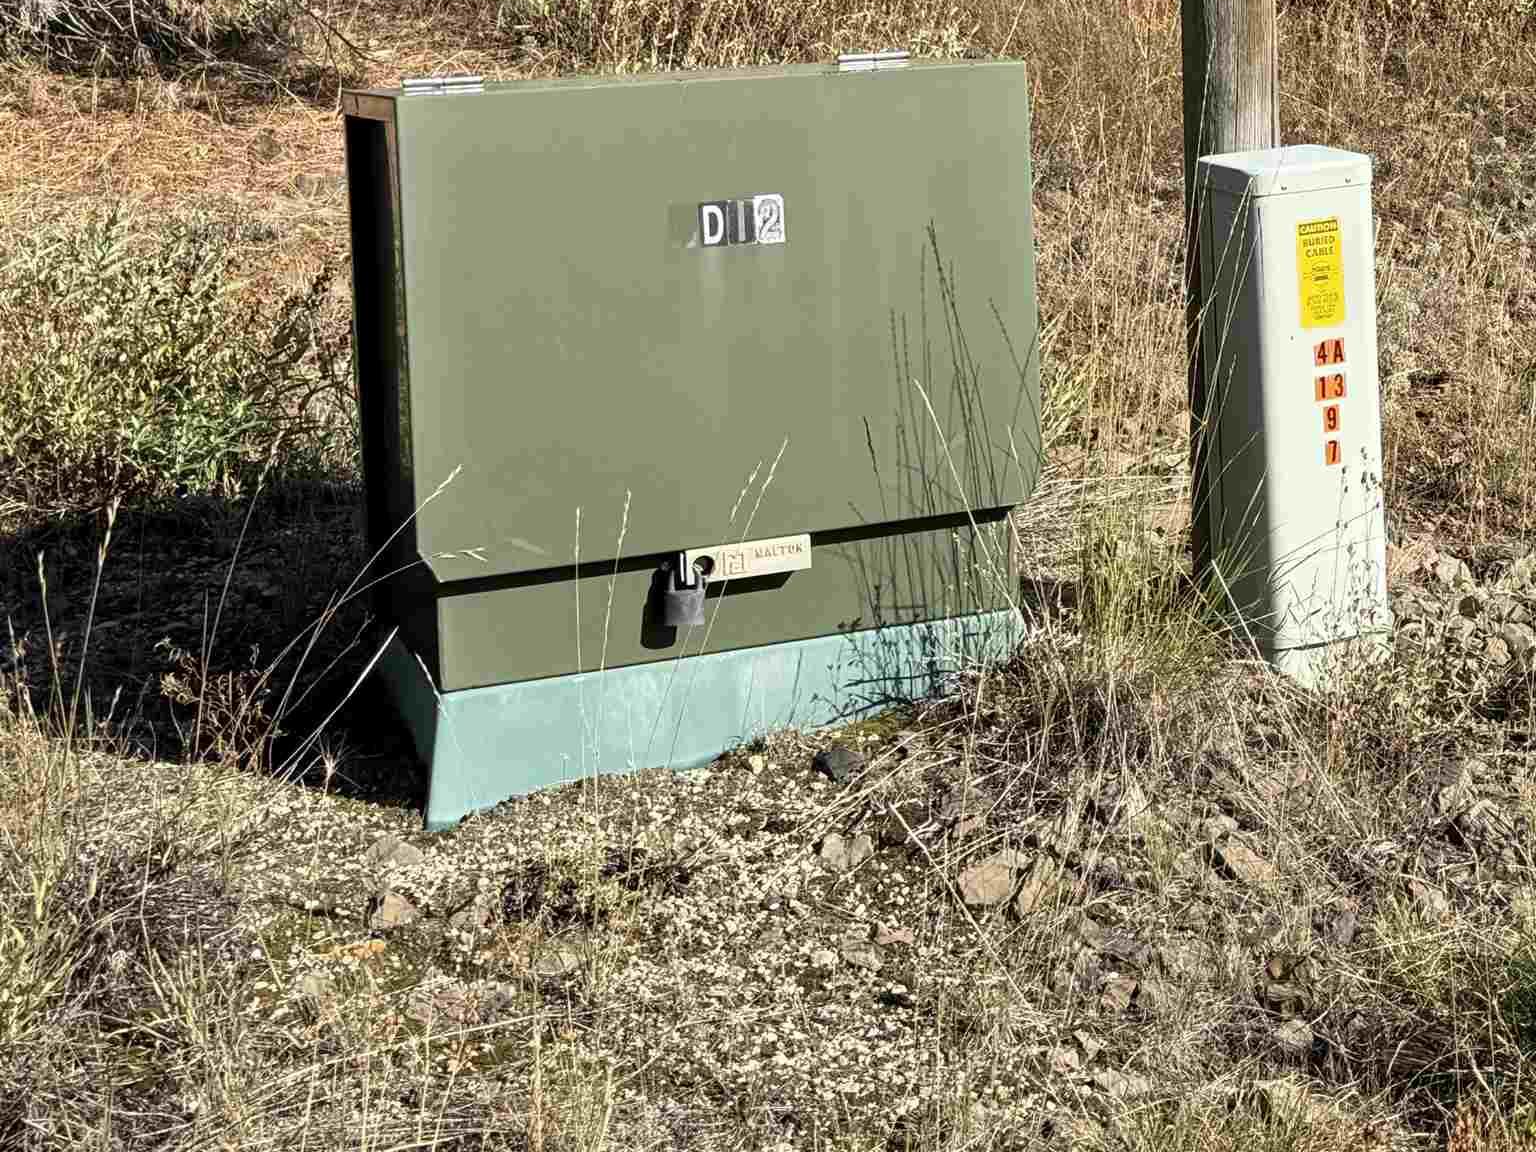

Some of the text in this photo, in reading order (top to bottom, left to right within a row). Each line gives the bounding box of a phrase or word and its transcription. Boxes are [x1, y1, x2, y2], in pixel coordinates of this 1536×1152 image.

[1300, 221, 1337, 234] CAUTION
[1303, 235, 1335, 247] BURIED
[1305, 247, 1334, 258] CABLE
[1317, 340, 1344, 364] 4A
[1319, 373, 1344, 398] 13
[1327, 407, 1337, 430] 9
[1328, 440, 1338, 463] 7
